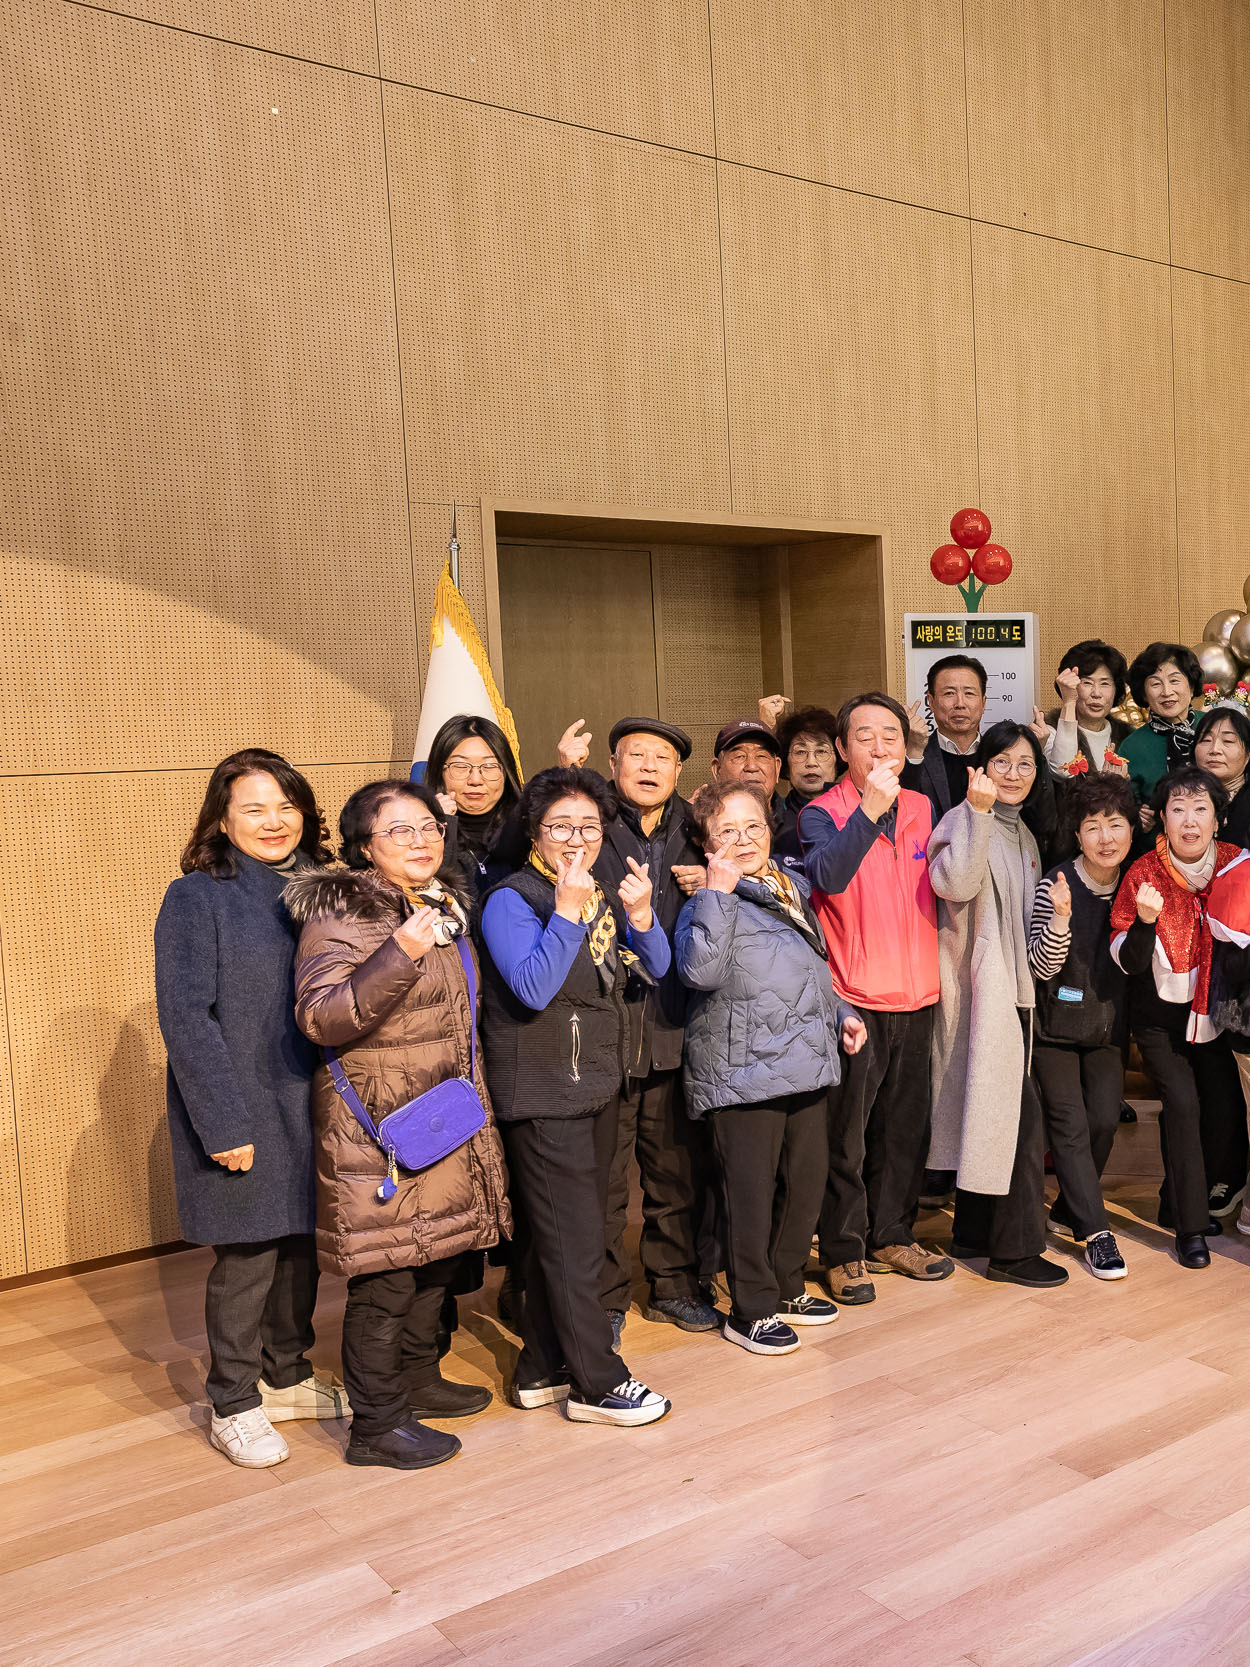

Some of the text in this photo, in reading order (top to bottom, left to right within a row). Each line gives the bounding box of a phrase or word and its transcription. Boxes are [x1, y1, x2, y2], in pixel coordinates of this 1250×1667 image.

[916, 625, 943, 643] 사랑의
[946, 625, 964, 642] 온도
[1001, 672, 1017, 680] 100
[1002, 694, 1013, 702] 90
